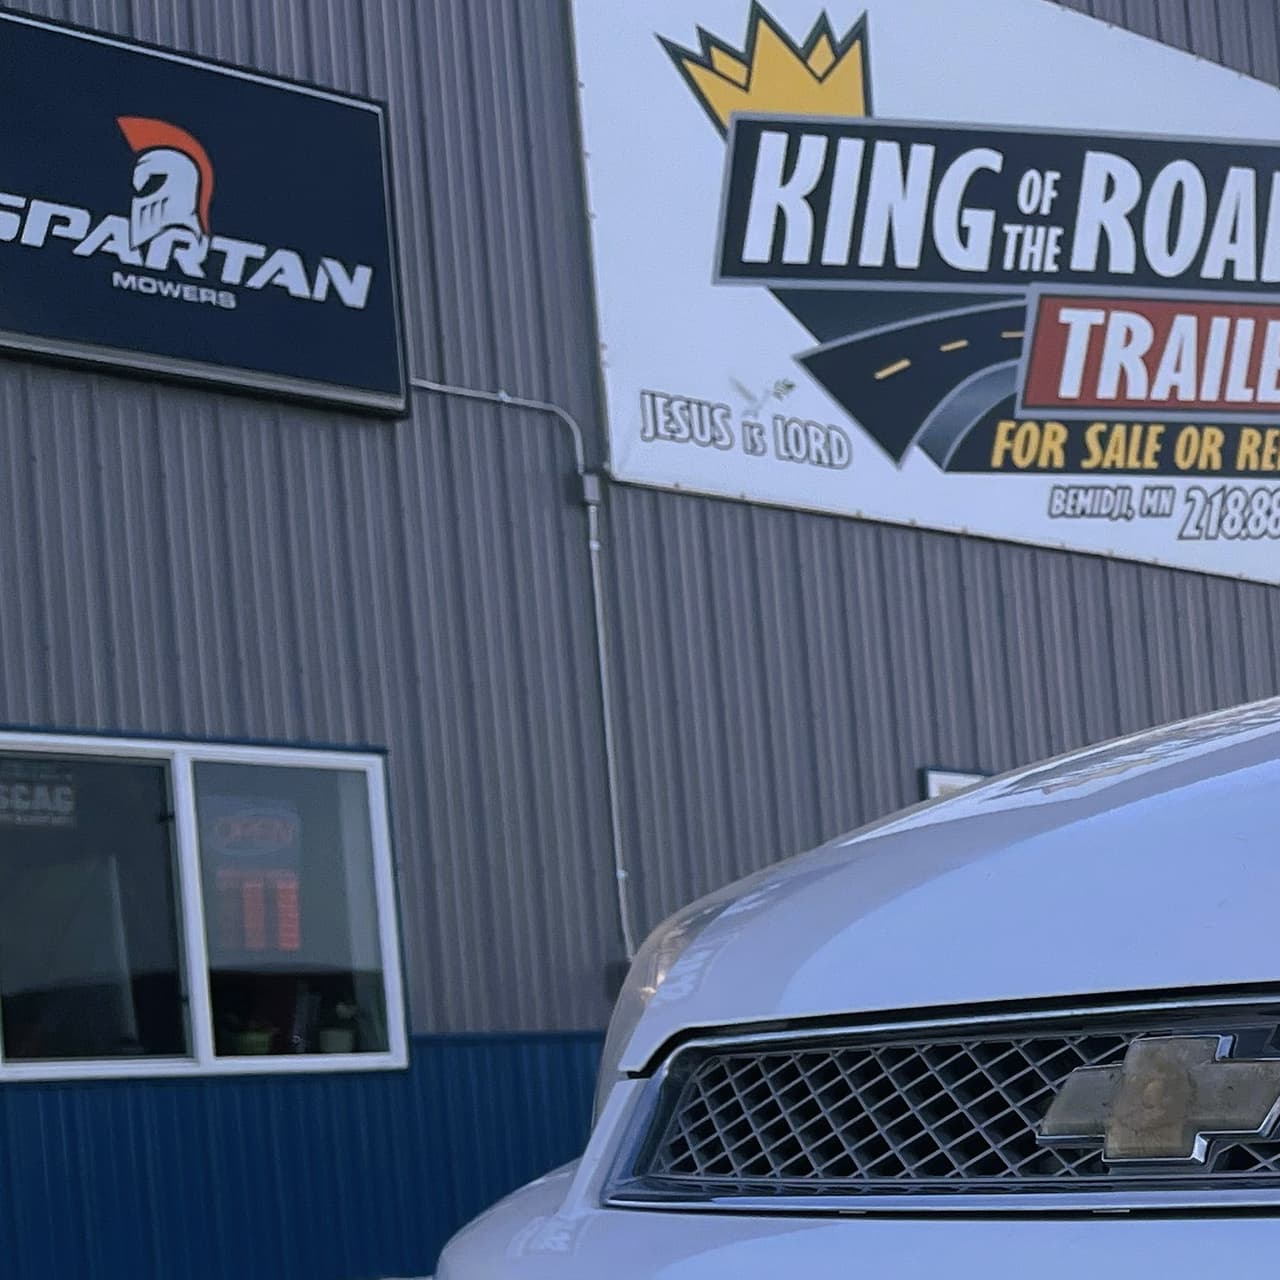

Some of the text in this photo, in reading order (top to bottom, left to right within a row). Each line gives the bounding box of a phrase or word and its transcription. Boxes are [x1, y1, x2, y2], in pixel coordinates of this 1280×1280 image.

[741, 131, 1003, 273] KING
[1016, 168, 1061, 215] OF
[1002, 223, 1064, 273] THE
[111, 271, 237, 310] MOWERS
[640, 389, 735, 451] JESUS
[772, 414, 853, 470] LORD
[990, 420, 1068, 469] FOR
[1080, 423, 1164, 470] SALE
[1174, 425, 1226, 472] OR
[1048, 485, 1133, 521] BEMIDJI,
[1139, 485, 1177, 519] MN
